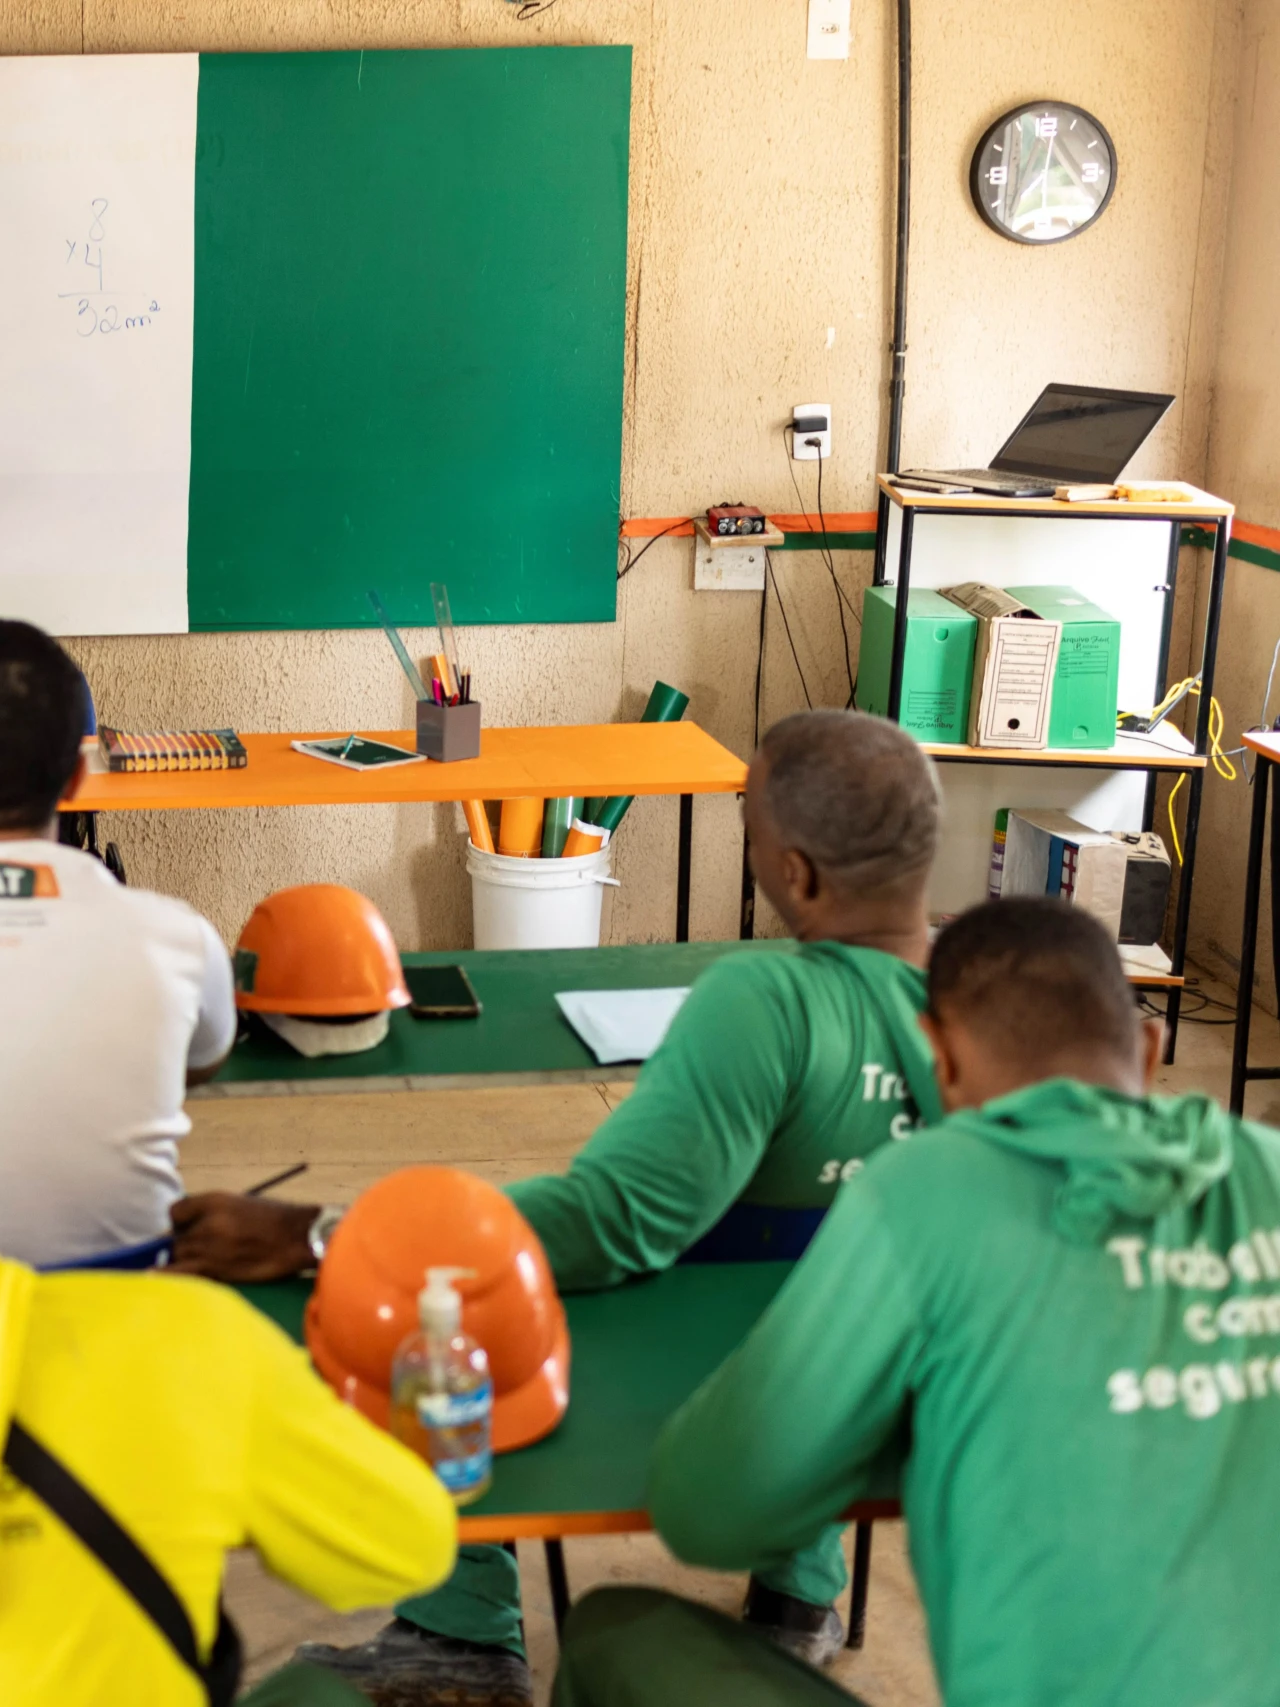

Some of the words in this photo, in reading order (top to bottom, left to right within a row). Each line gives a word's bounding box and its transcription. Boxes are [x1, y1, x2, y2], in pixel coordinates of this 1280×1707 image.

[1035, 117, 1057, 137] 12
[1081, 162, 1099, 183] 3
[88, 198, 109, 242] 8
[84, 243, 103, 291] 4
